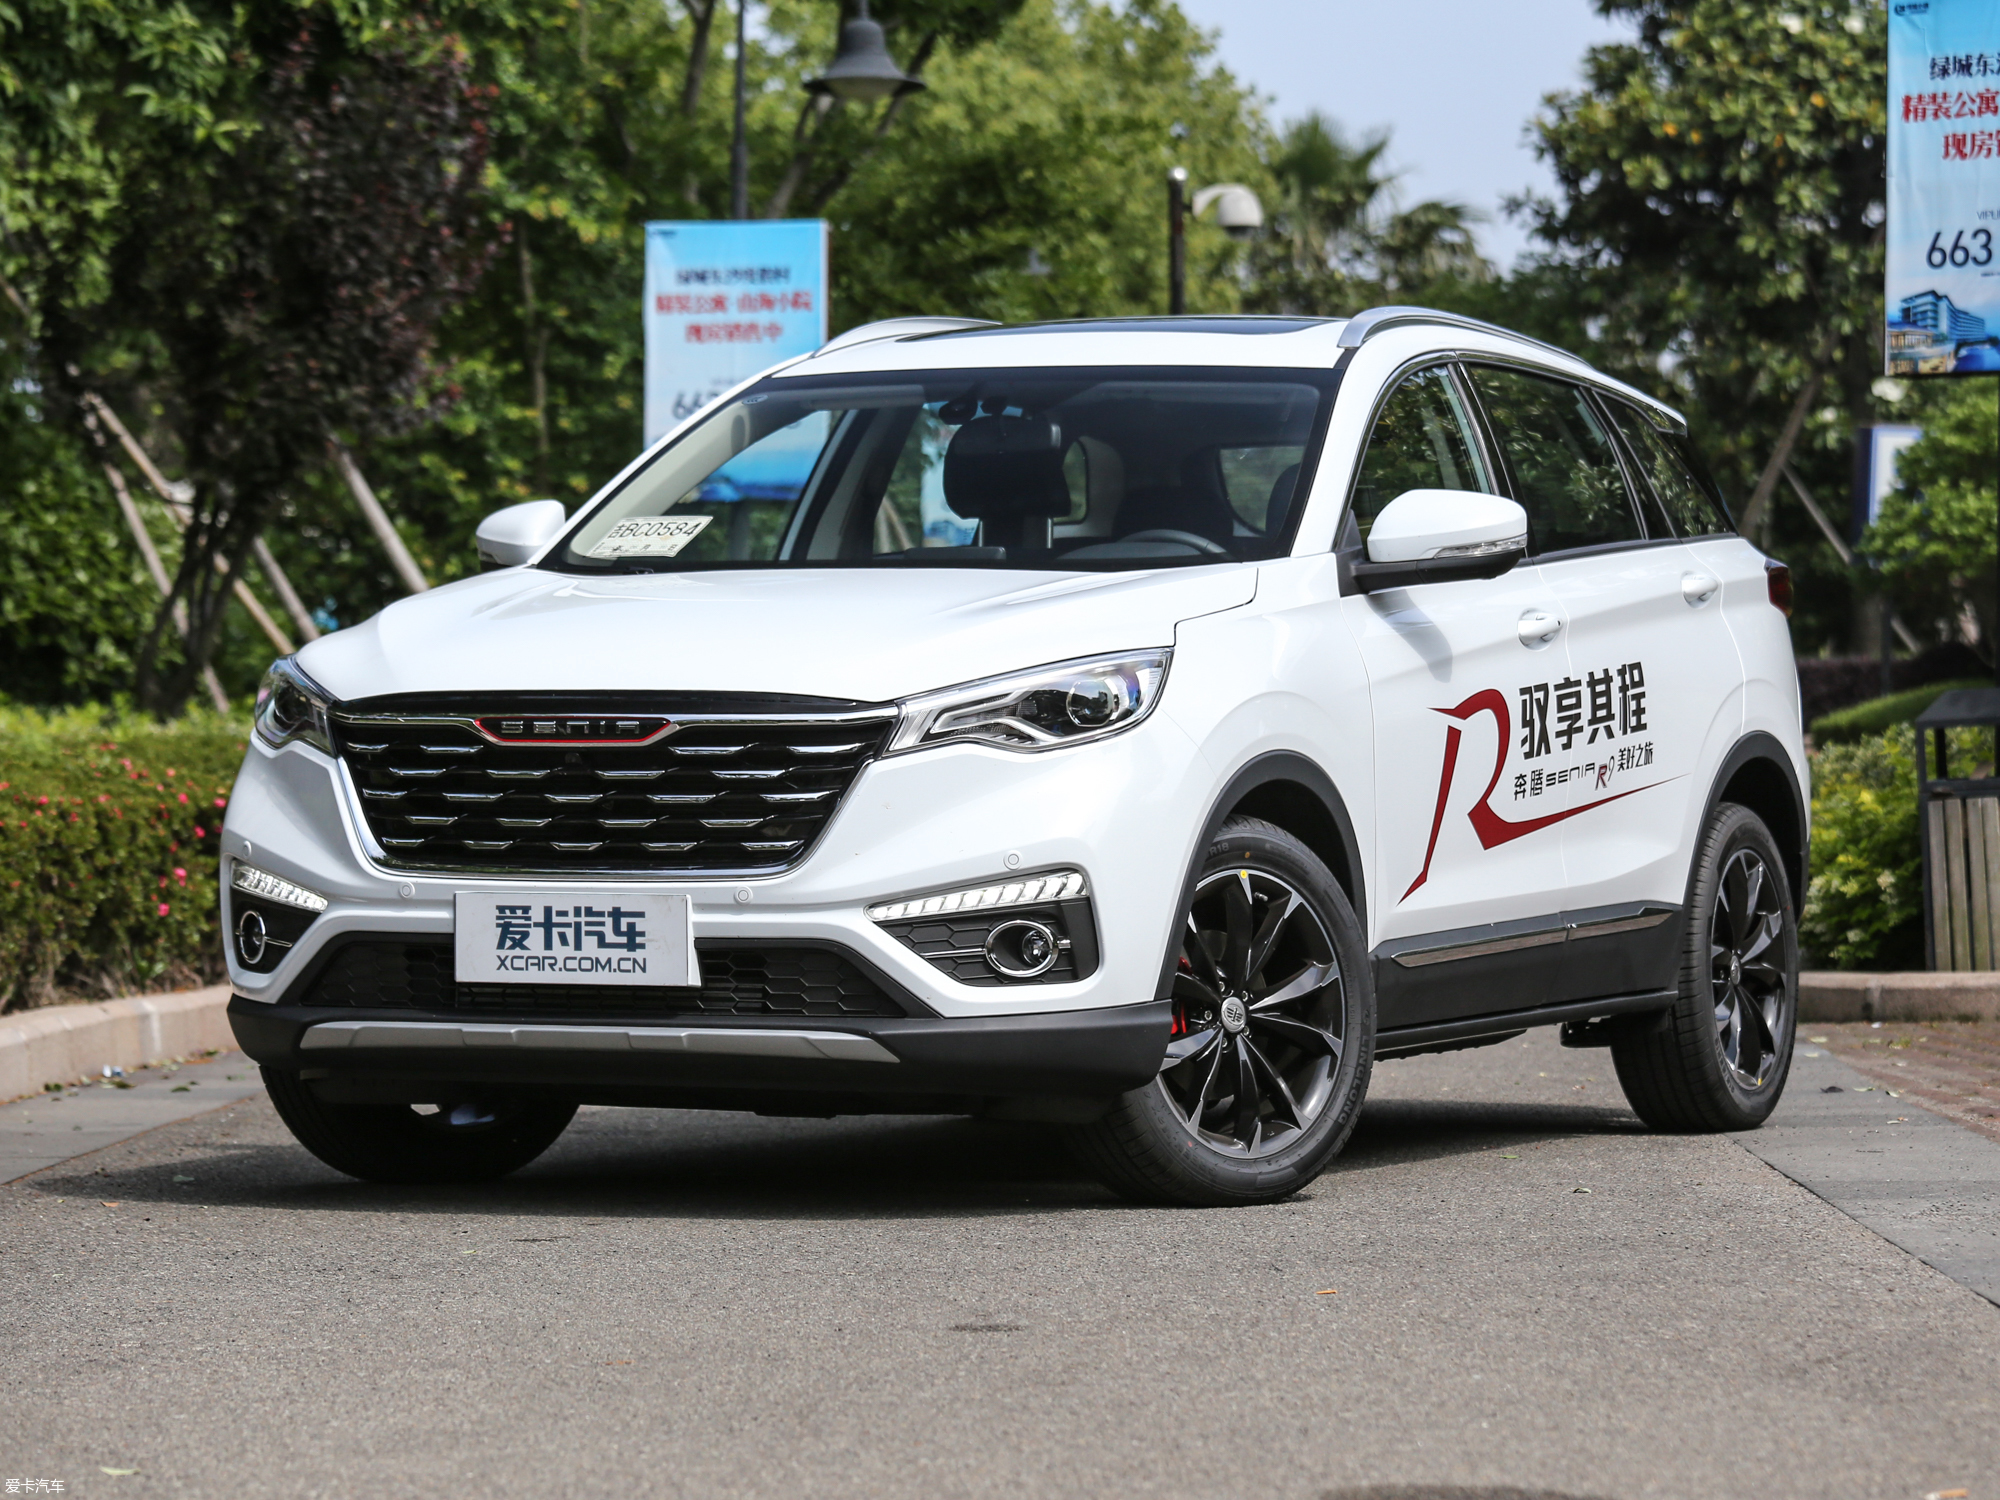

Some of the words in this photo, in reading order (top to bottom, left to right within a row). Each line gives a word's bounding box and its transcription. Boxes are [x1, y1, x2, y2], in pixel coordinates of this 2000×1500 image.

[1930, 53, 2000, 80] 绿城东
[1901, 88, 2000, 123] 精装公寓
[1943, 130, 2000, 161] 现房
[1926, 228, 1993, 271] 663
[501, 720, 640, 735] SENIA
[1518, 661, 1648, 761] 驭享其程
[495, 905, 646, 953] 爱卡汽车
[495, 955, 647, 974] XCAR.COM.CN
[1337, 1034, 1370, 1126] LINGLONG
